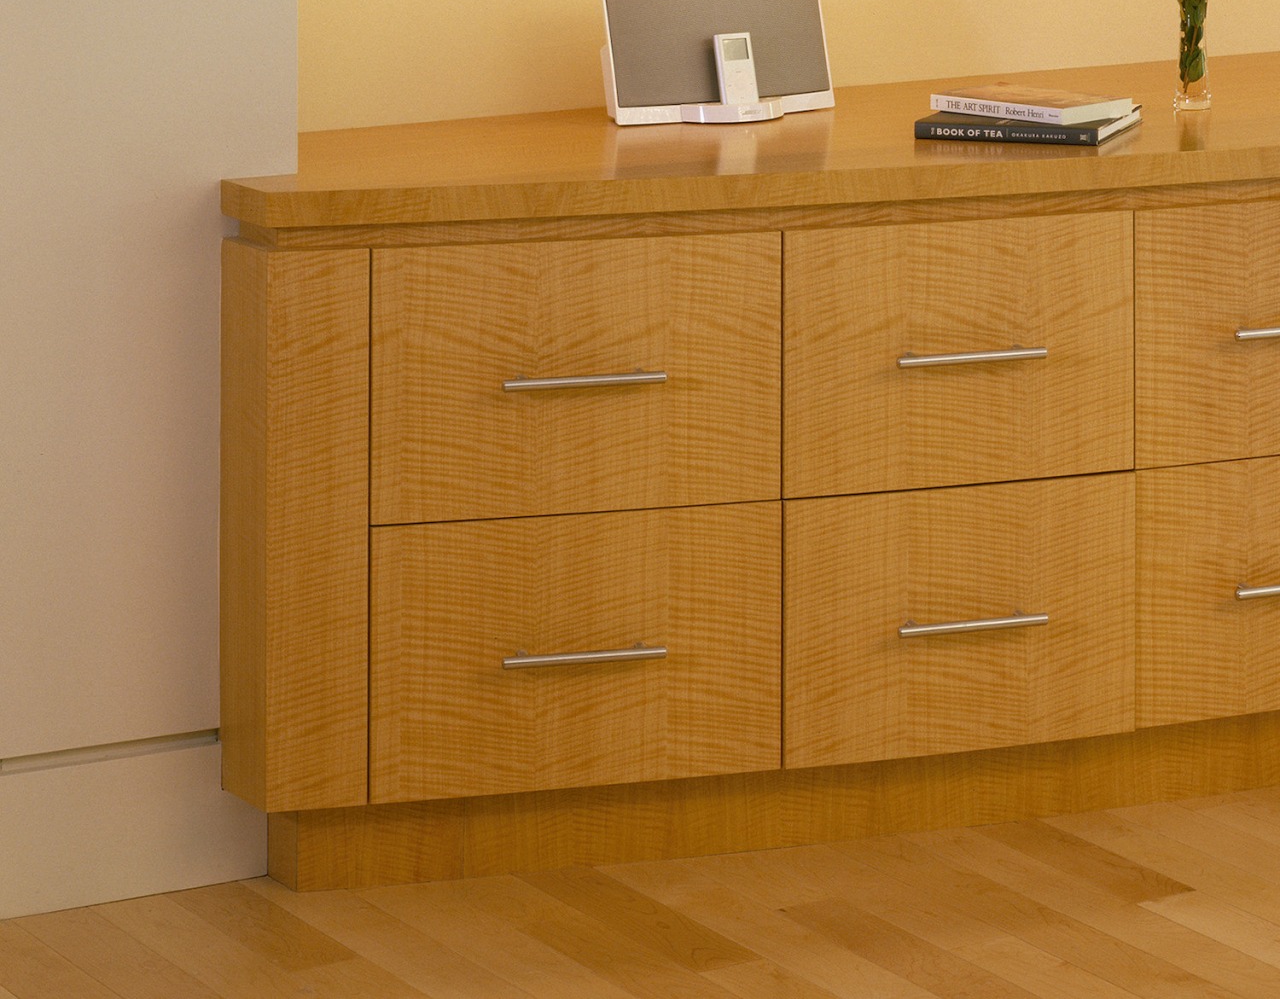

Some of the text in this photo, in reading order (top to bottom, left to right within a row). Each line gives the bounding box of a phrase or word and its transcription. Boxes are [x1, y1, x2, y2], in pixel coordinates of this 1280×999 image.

[945, 100, 961, 110] THE
[962, 102, 978, 112] ART
[978, 103, 1001, 114] SPIRIT
[1005, 106, 1026, 117] Robert
[1027, 108, 1045, 119] Henri
[936, 127, 965, 137] BOOK
[967, 129, 981, 138] OF
[983, 130, 1004, 139] TEA
